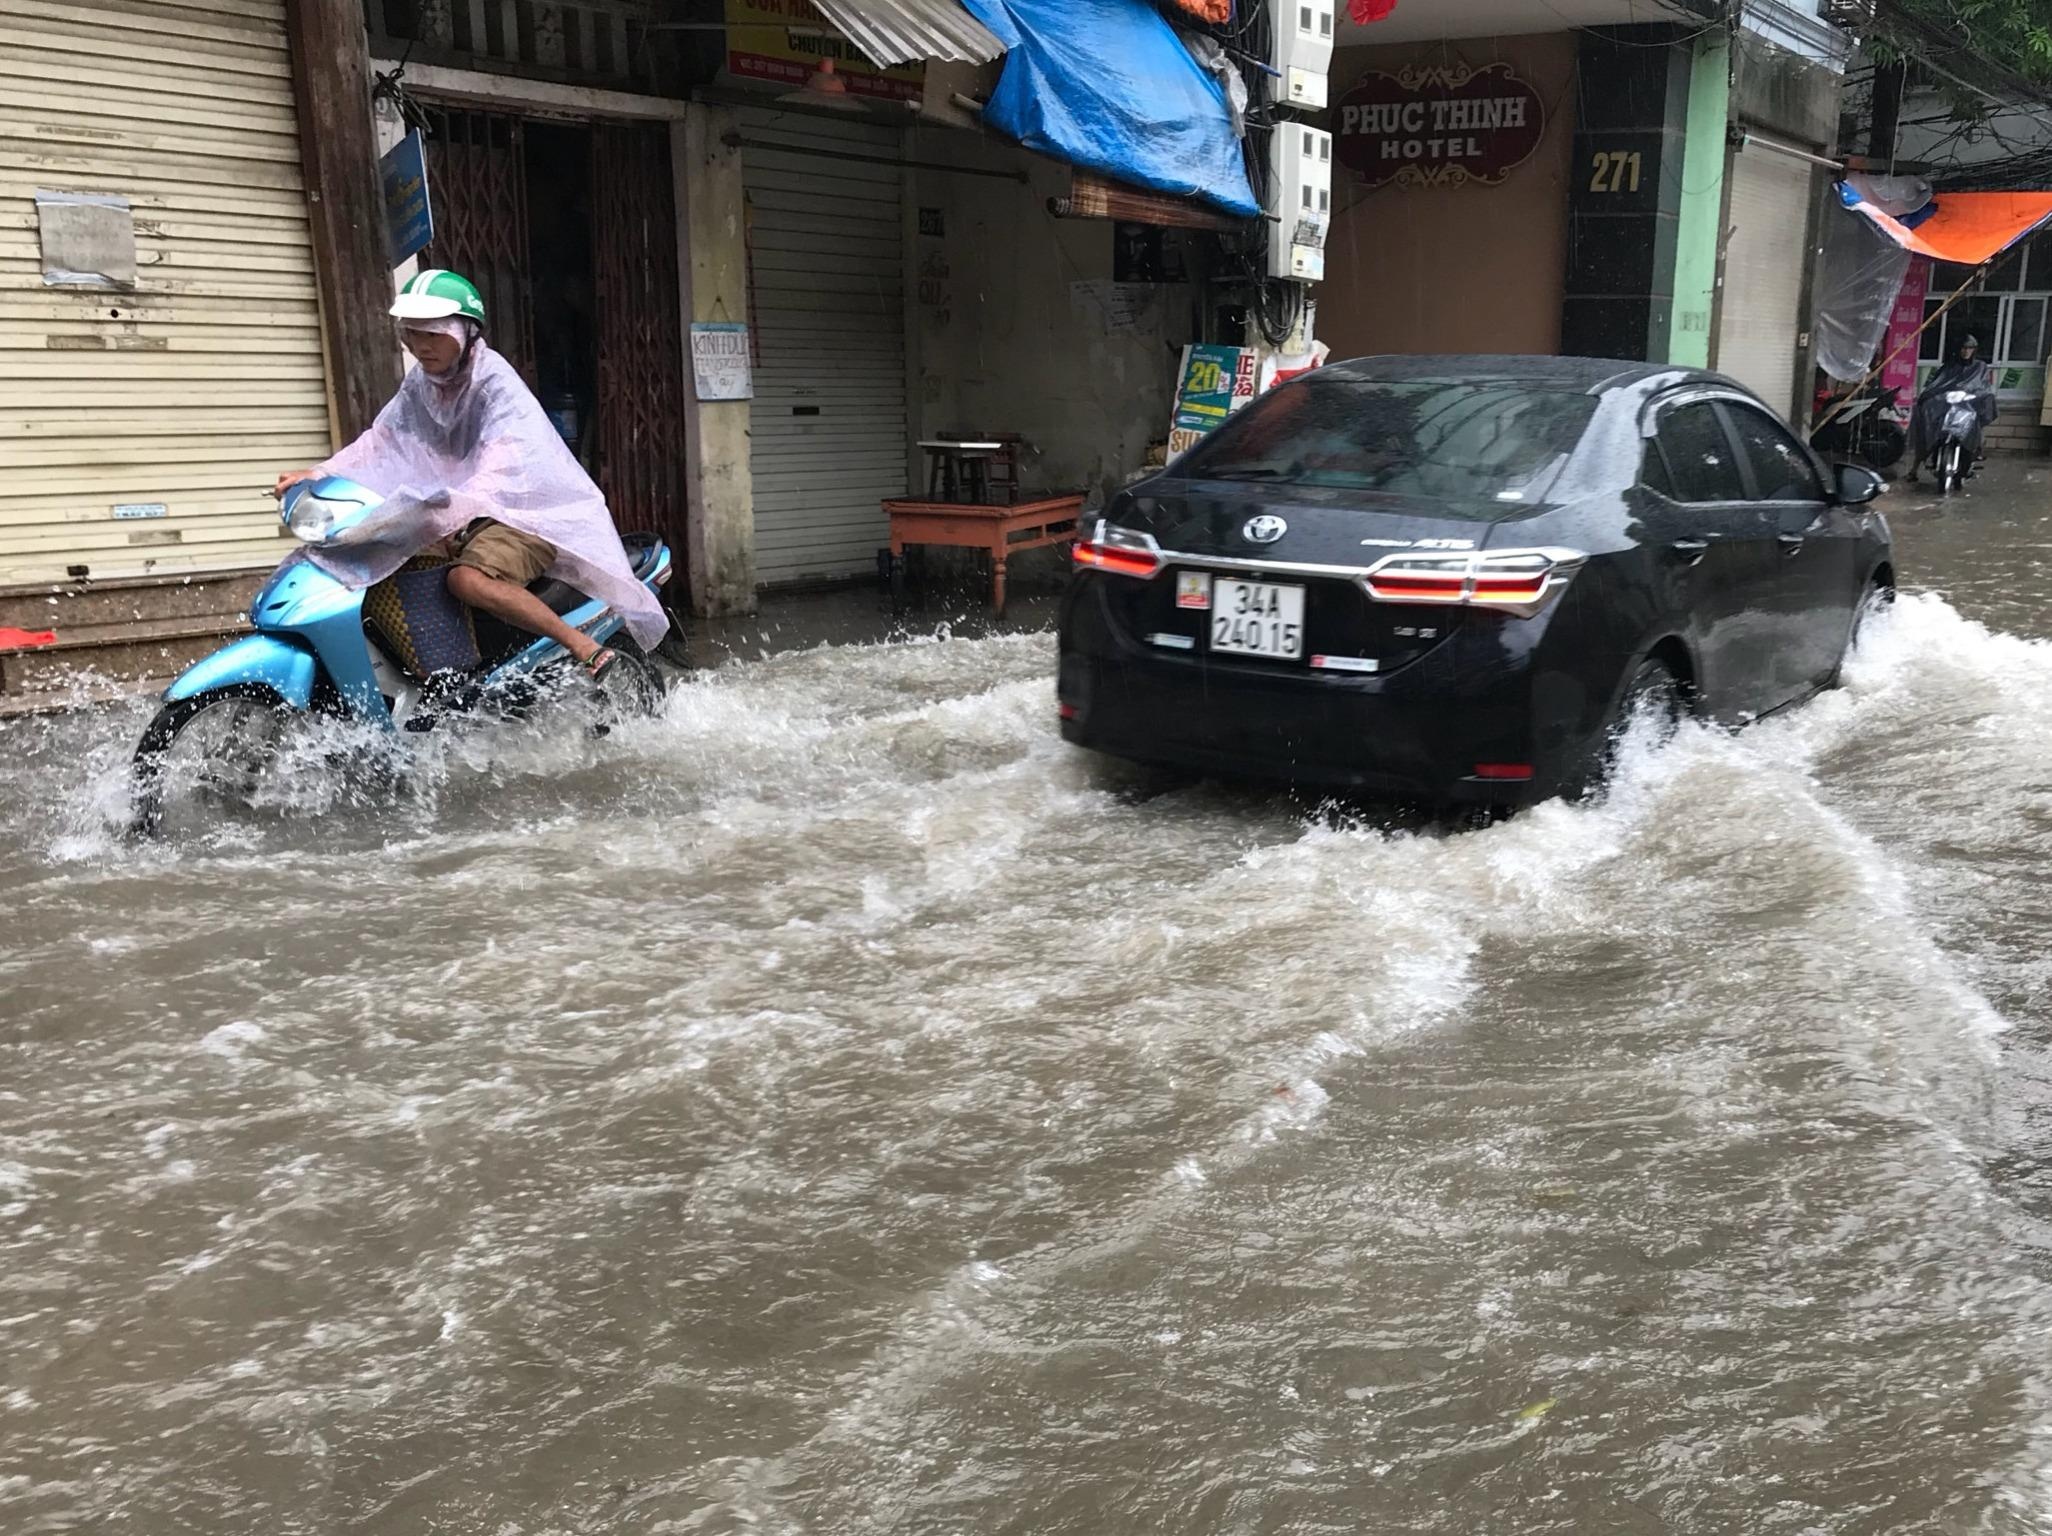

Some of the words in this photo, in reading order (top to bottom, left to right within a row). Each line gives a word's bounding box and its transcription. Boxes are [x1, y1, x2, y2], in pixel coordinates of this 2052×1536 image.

[1341, 102, 1424, 135] PHUC
[1430, 97, 1527, 131] THINH
[1380, 138, 1483, 159] HOTEL
[1589, 151, 1642, 193] 271
[1186, 360, 1221, 393] 20
[1235, 585, 1281, 618] 34A
[1214, 616, 1301, 653] 240.15
